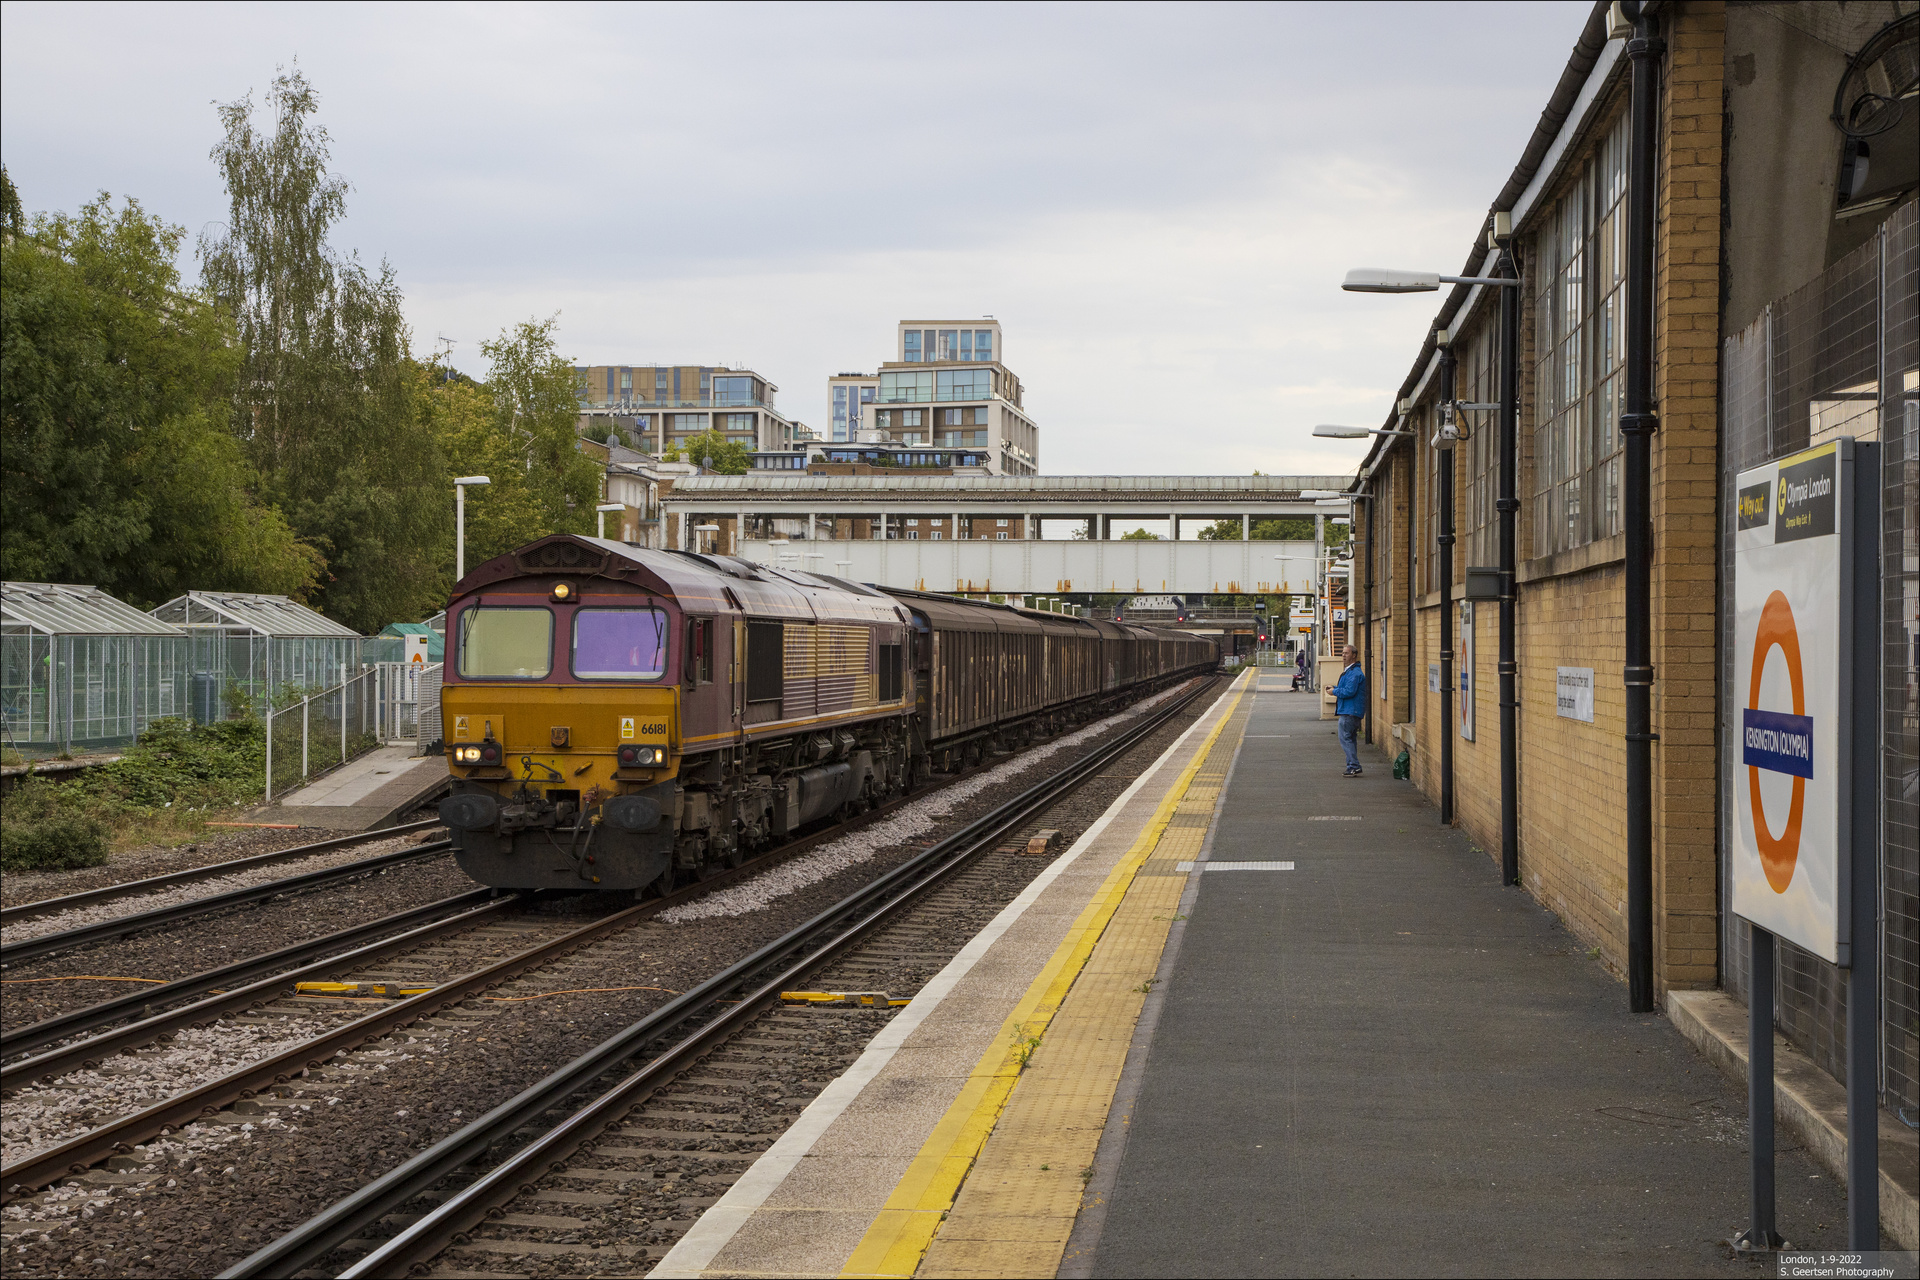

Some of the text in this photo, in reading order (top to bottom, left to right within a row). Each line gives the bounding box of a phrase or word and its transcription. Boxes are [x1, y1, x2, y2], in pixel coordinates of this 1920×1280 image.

[1787, 474, 1831, 507] Olympia London
[1744, 493, 1764, 520] Way out
[1337, 611, 1342, 619] 2
[641, 723, 666, 735] 66181
[1746, 727, 1808, 761] KENSINGTON (OLYMPIA)
